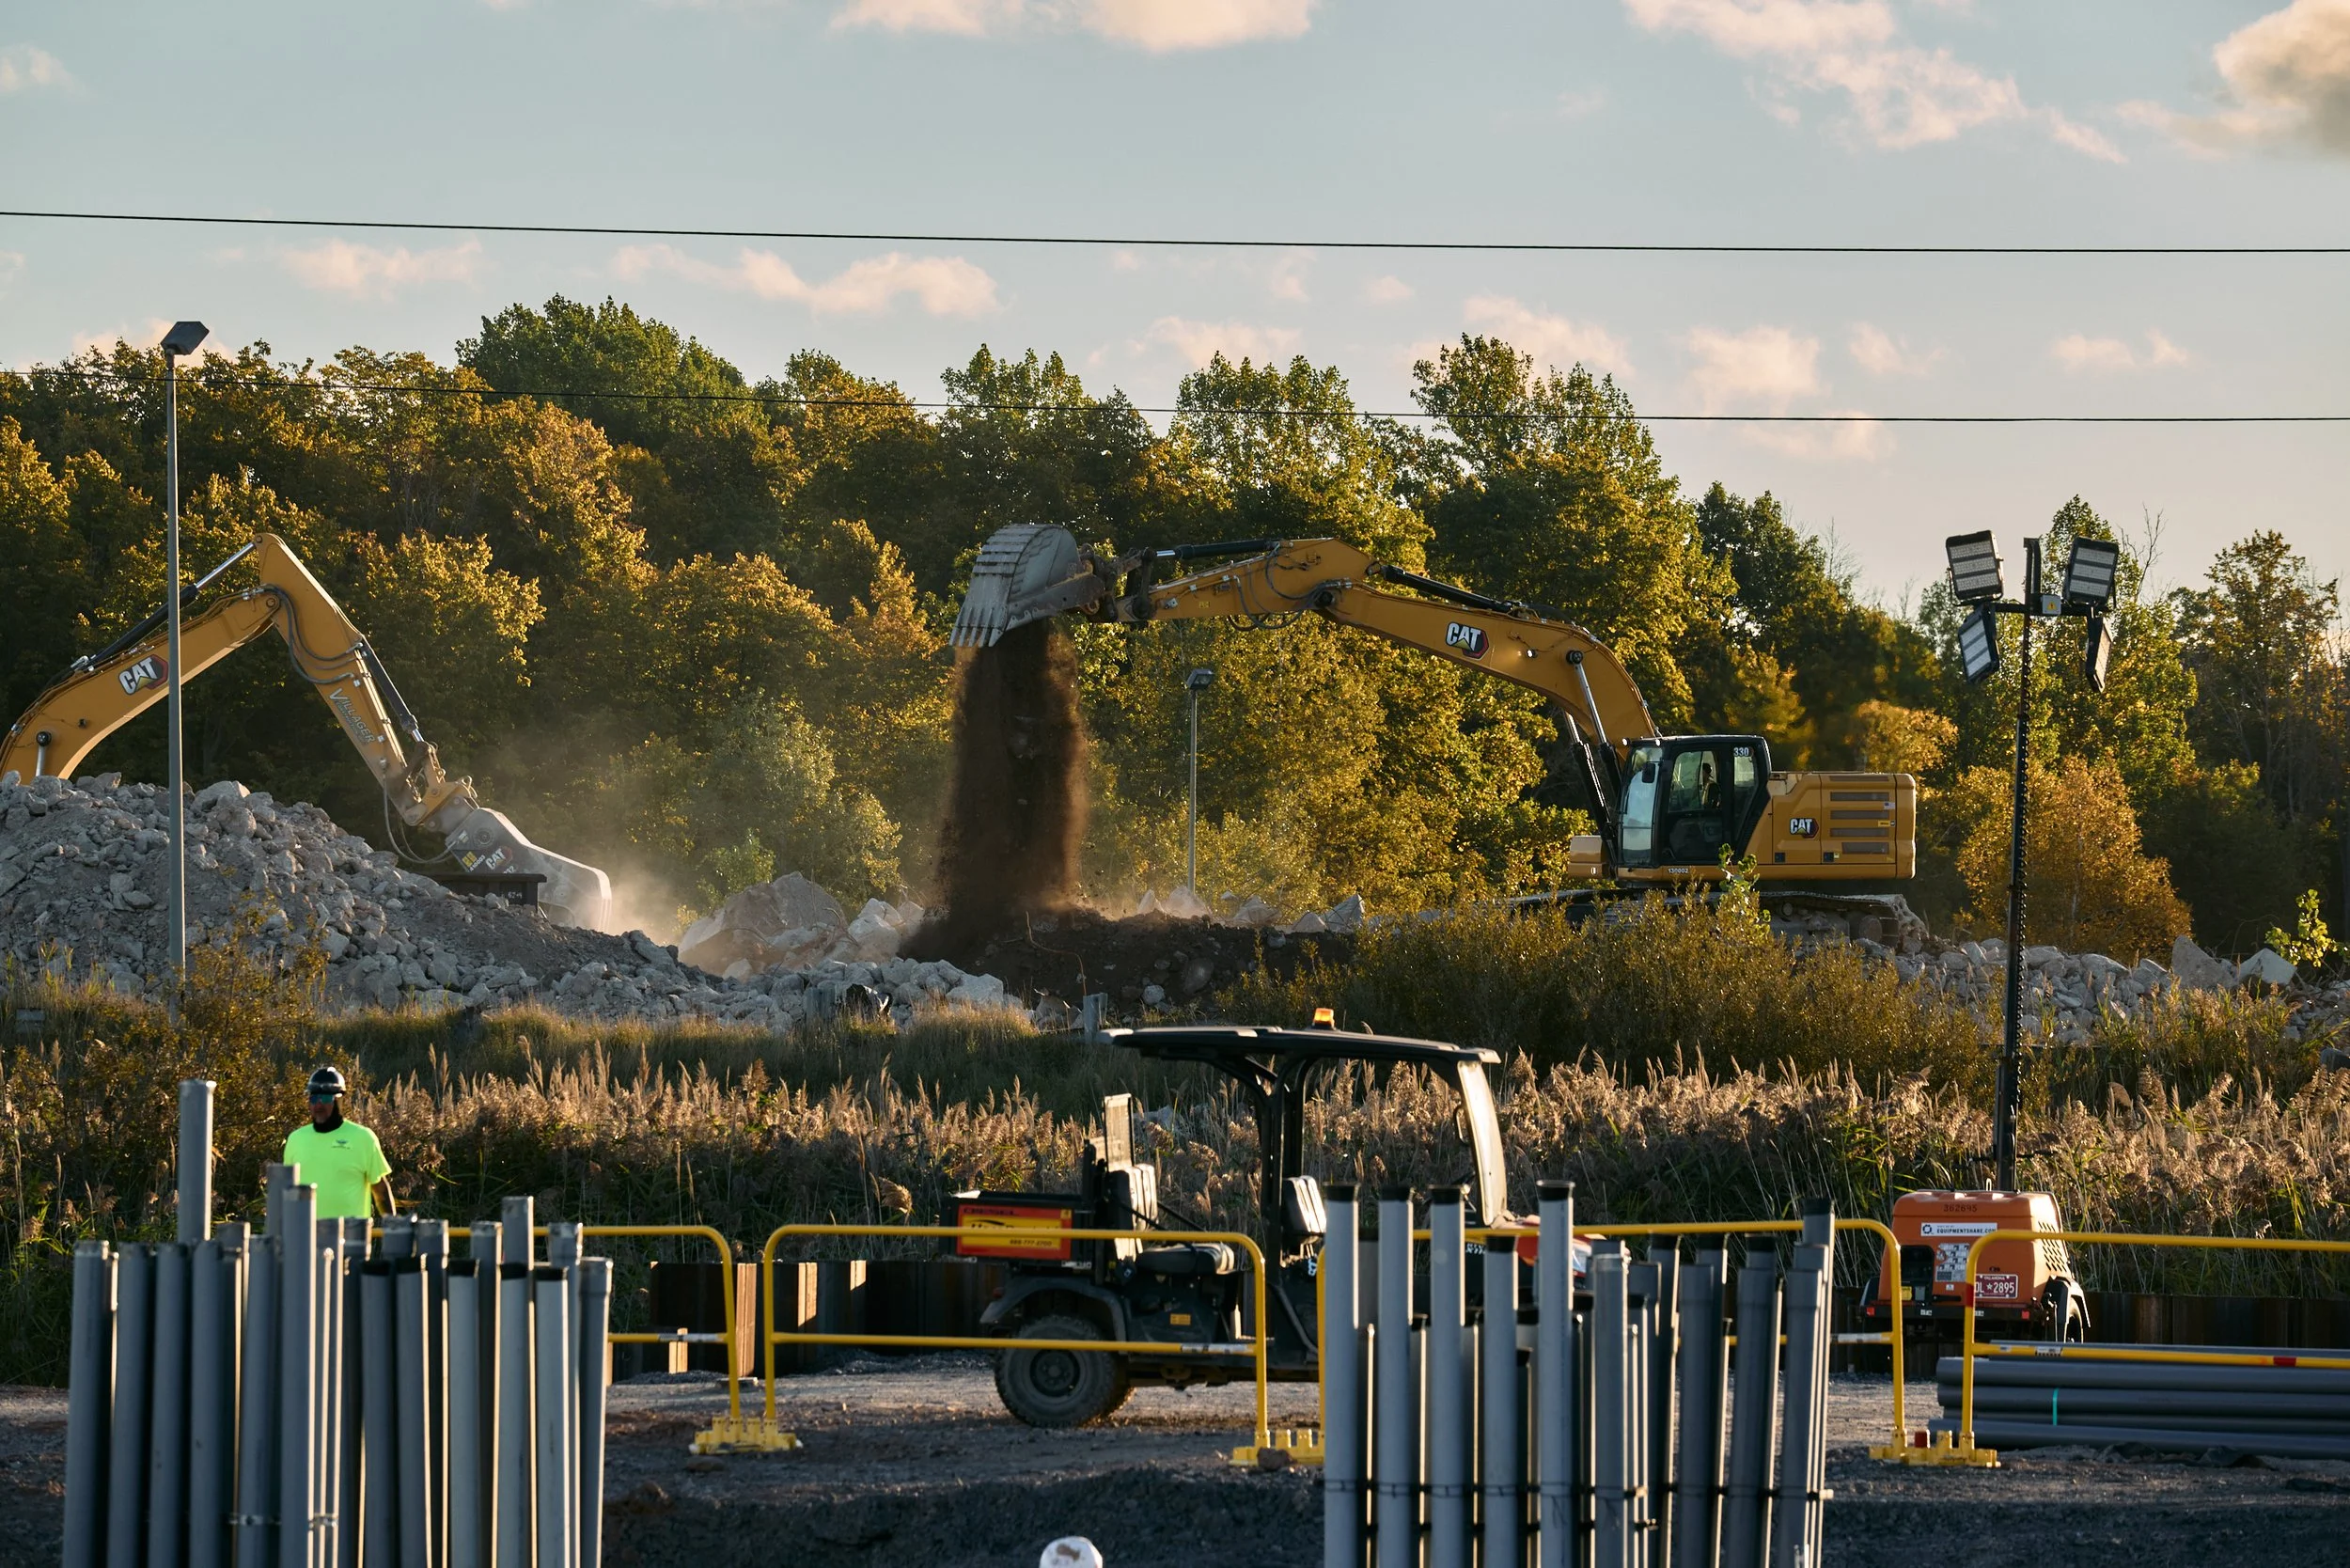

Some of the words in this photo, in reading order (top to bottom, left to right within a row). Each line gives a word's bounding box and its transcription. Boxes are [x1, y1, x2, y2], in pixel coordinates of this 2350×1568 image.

[1447, 622, 1480, 651] CAT
[119, 657, 157, 694] CAT
[330, 688, 375, 743] VILLAGER
[1733, 747, 1749, 756] 330
[1790, 819, 1812, 834] CAT
[486, 848, 506, 870] CAT
[1993, 1281, 2014, 1293] 2895
